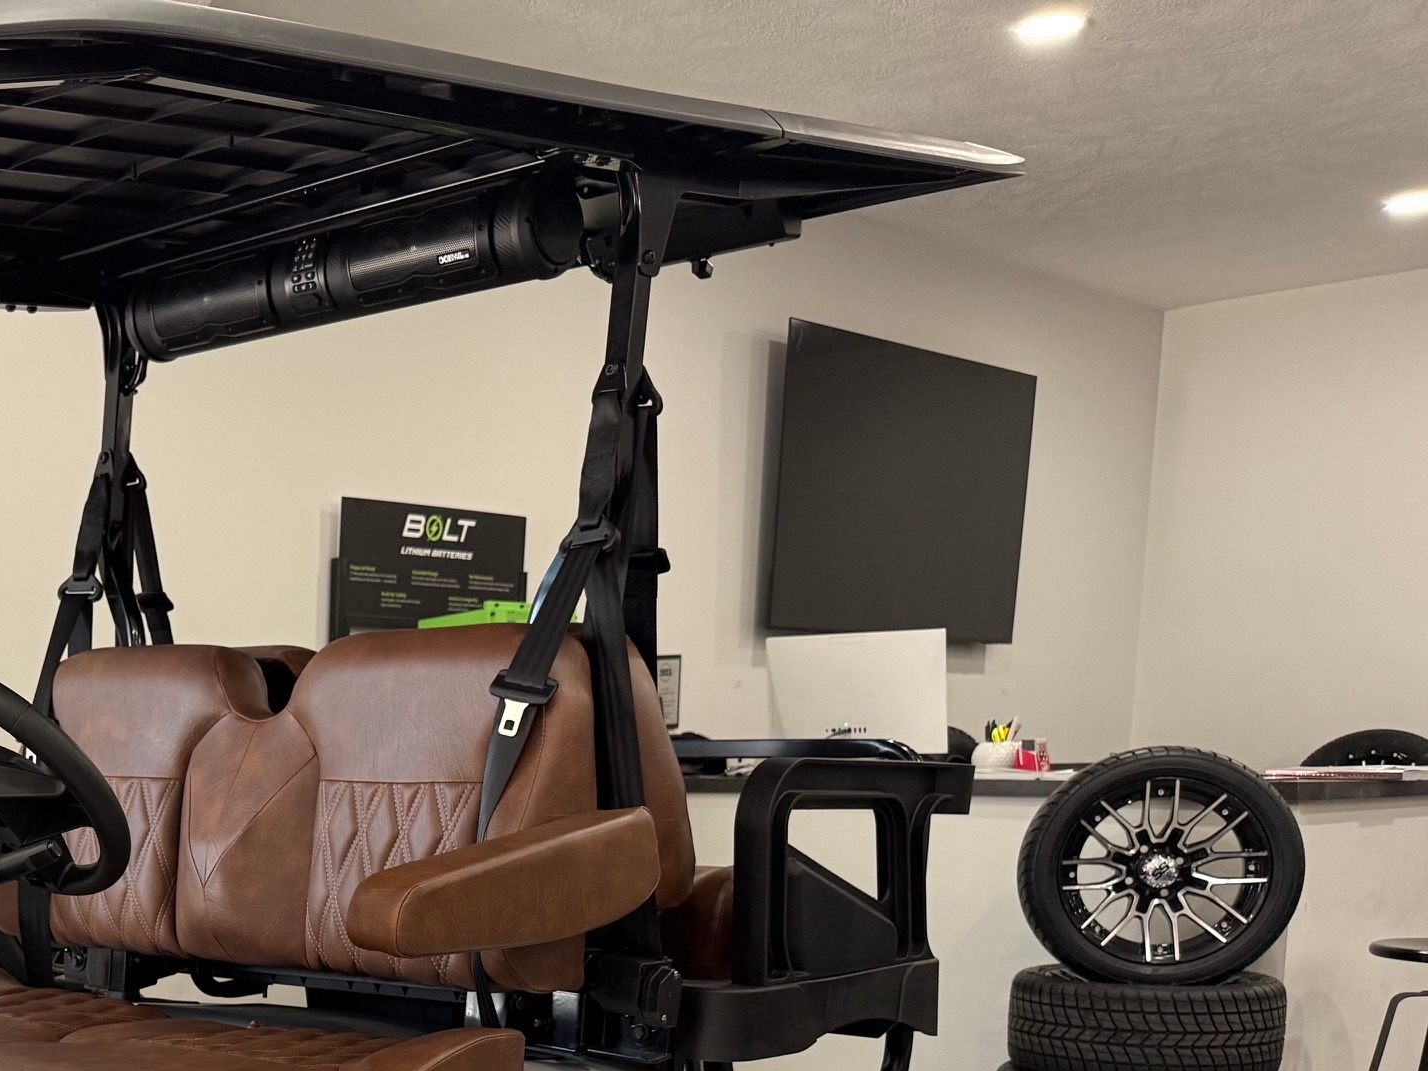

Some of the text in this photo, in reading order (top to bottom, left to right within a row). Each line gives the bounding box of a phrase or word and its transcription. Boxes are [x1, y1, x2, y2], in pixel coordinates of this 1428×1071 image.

[402, 513, 477, 542] BOLT
[400, 546, 473, 560] LITHIUM BATTERIES
